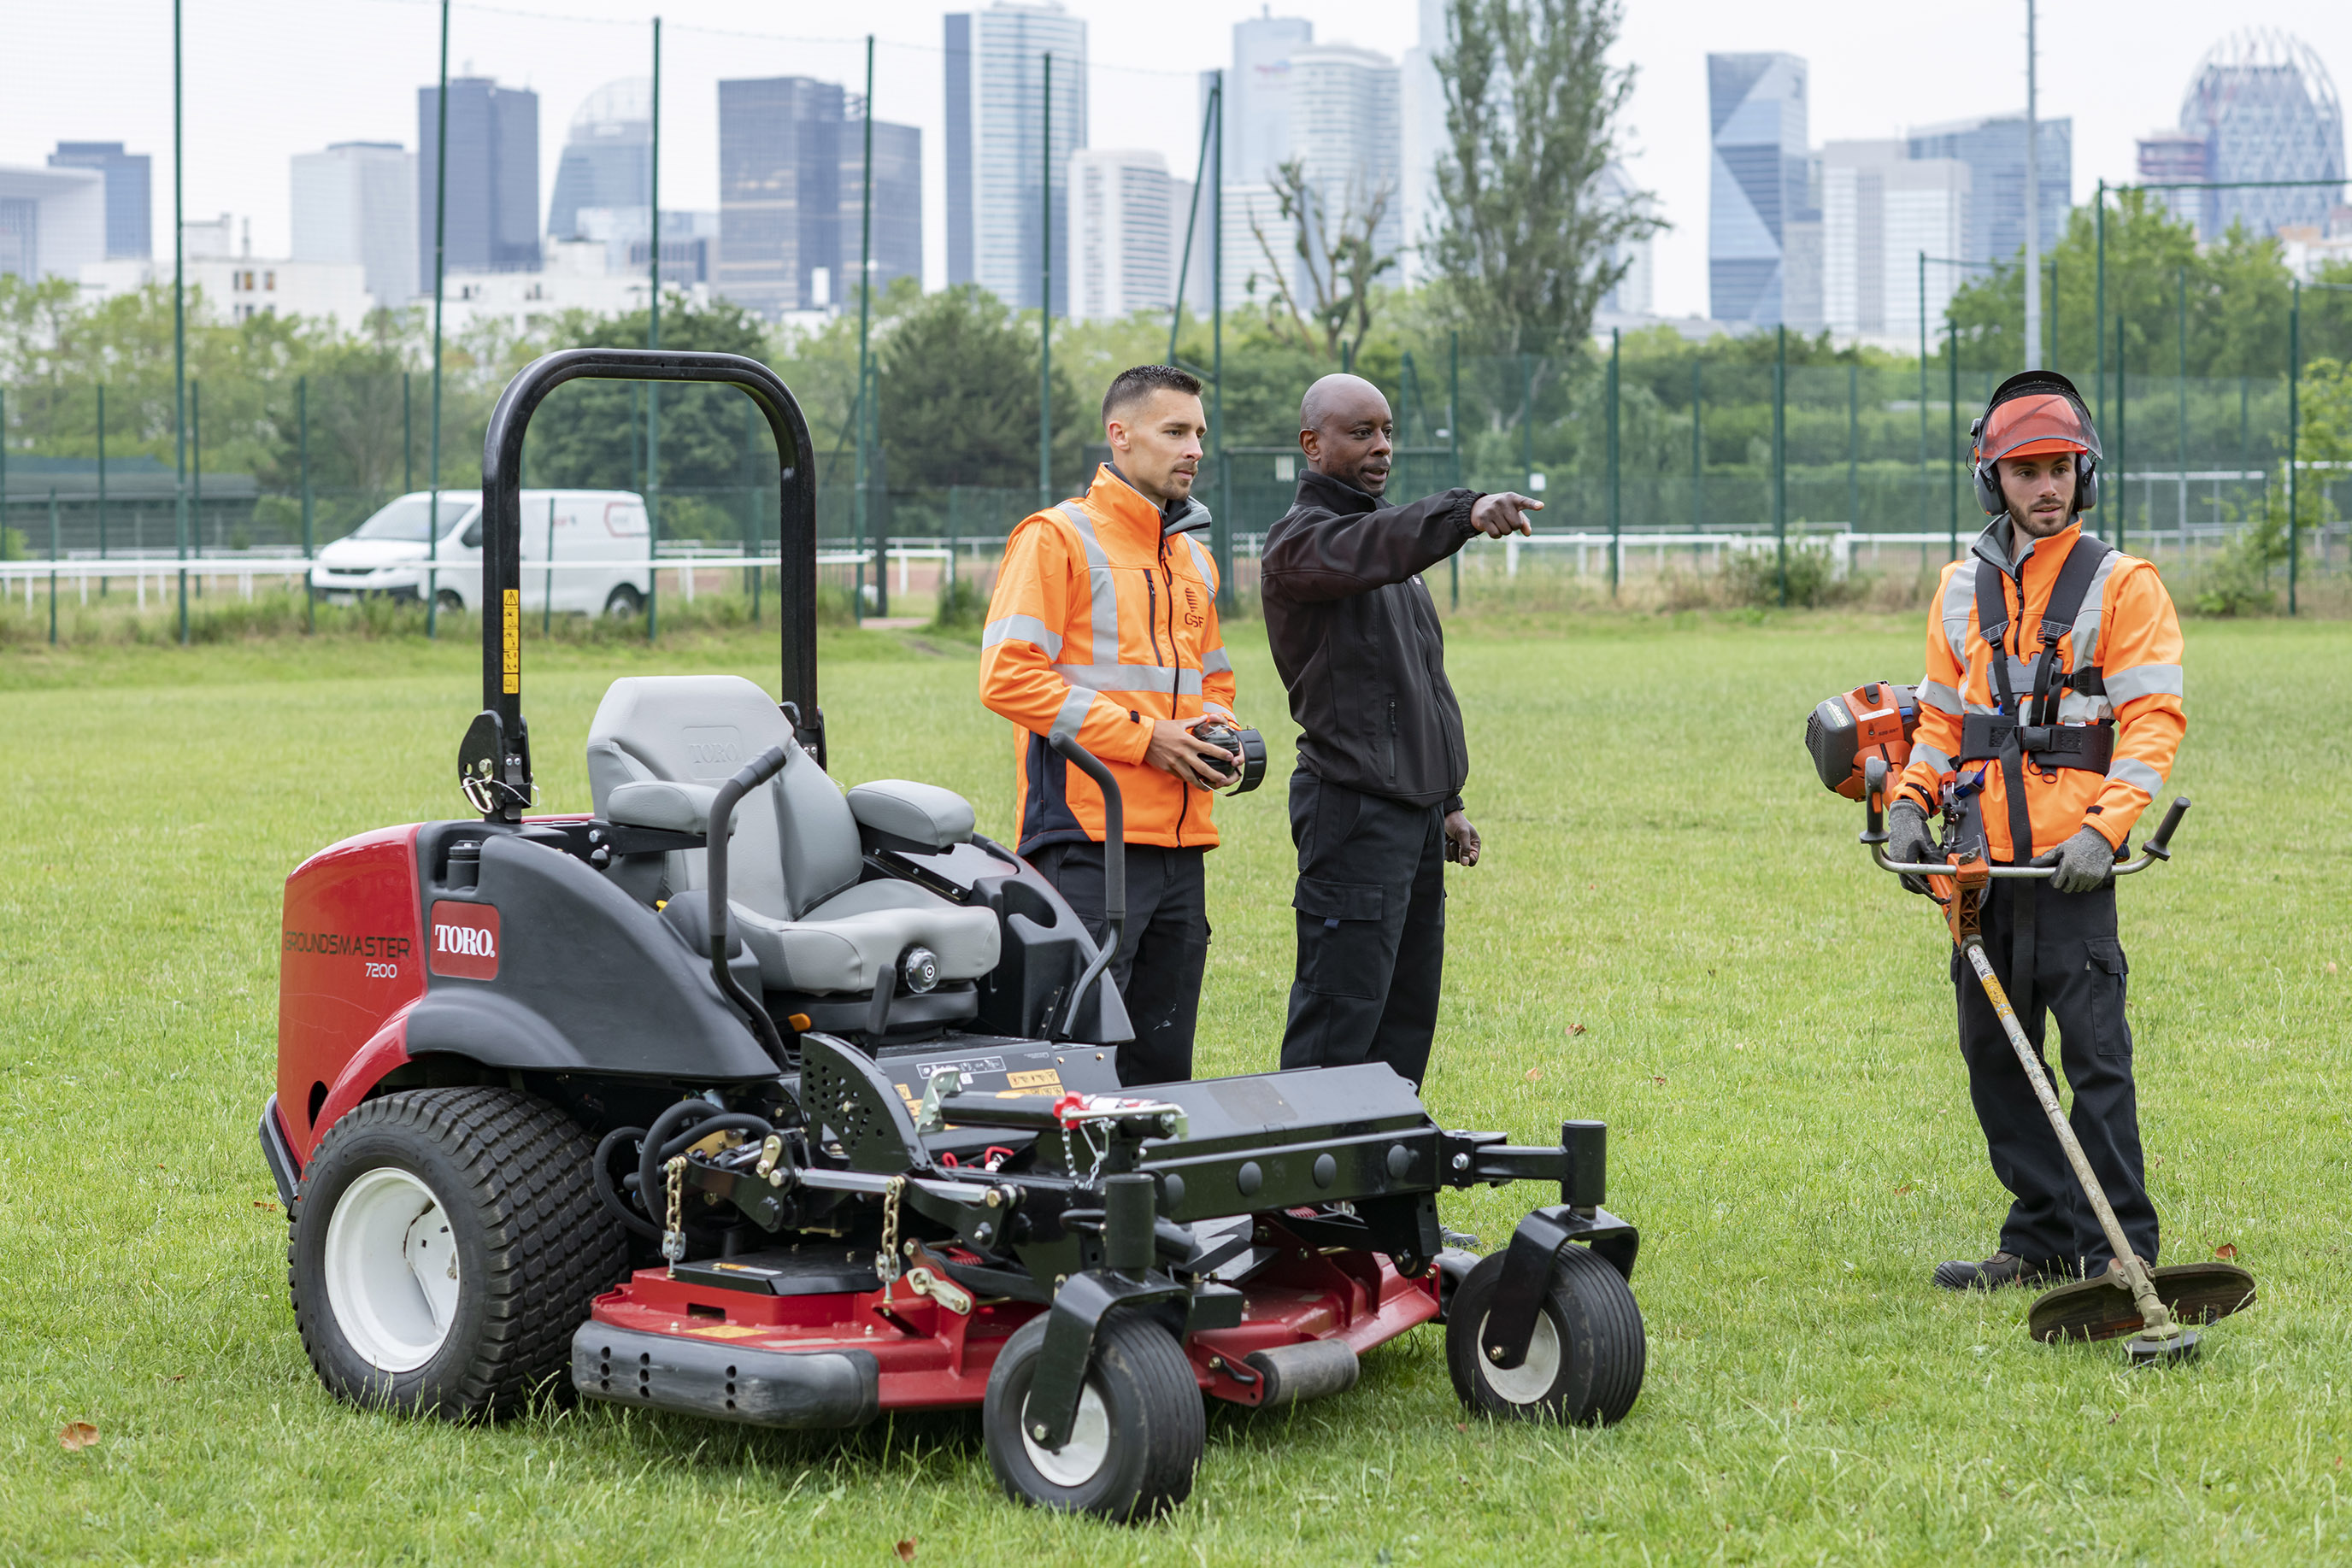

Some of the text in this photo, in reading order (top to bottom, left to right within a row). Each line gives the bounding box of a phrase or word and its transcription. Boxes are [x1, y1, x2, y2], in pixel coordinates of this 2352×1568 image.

[1185, 613, 1204, 628] GSF
[689, 743, 738, 764] TORO
[285, 931, 410, 958] GROUNDSMASTER
[366, 964, 397, 978] 7200
